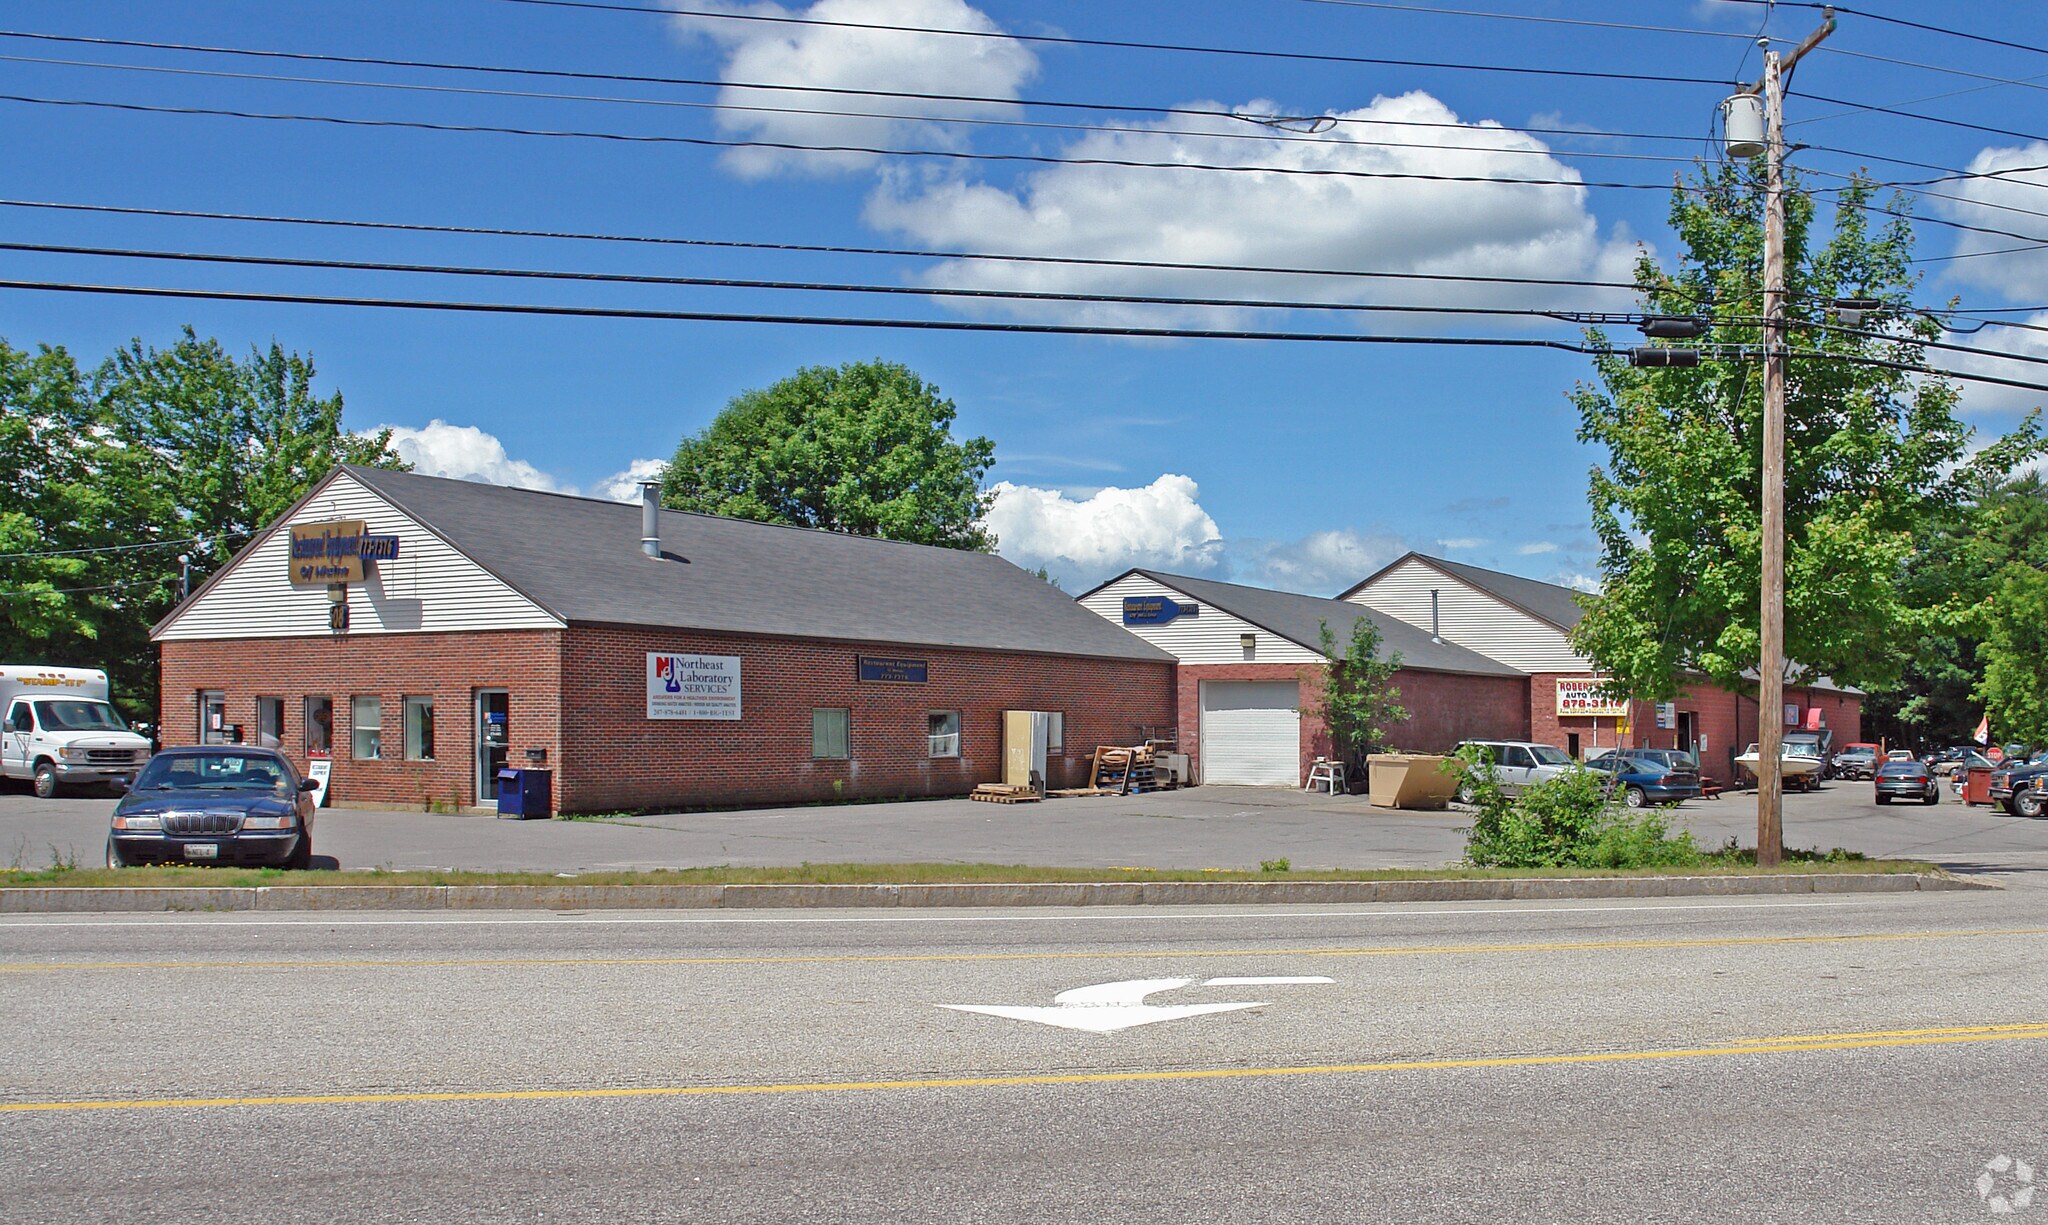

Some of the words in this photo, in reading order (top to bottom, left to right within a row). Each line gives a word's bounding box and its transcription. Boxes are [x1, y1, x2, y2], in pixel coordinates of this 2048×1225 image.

[676, 657, 724, 670] Northeast
[680, 671, 734, 687] Laboratory
[684, 684, 728, 694] SERVICES
